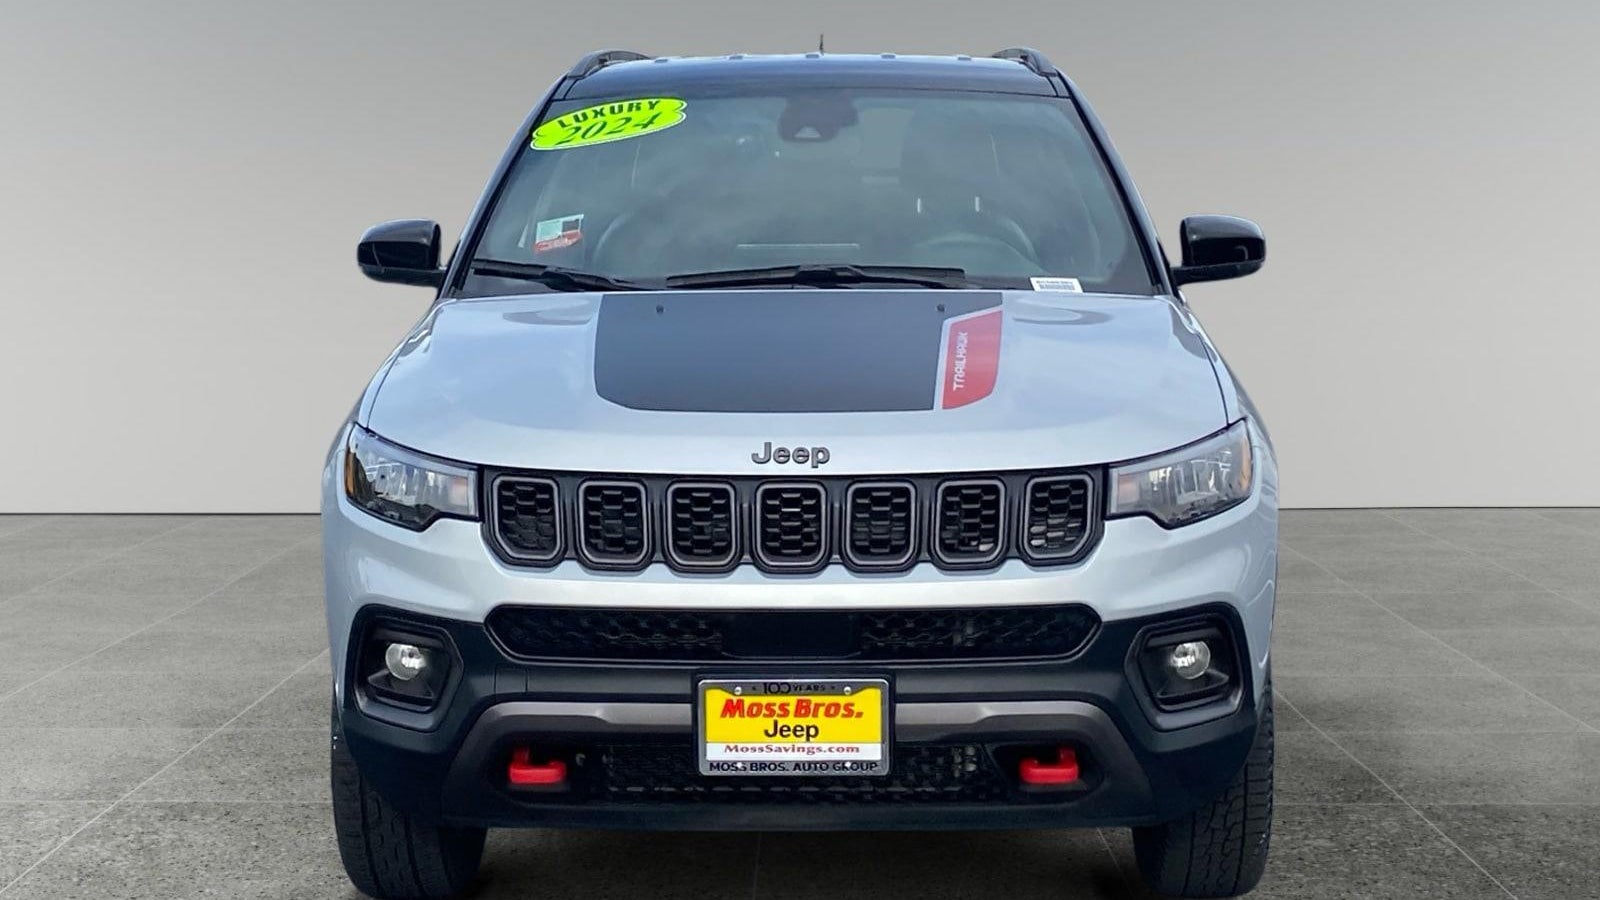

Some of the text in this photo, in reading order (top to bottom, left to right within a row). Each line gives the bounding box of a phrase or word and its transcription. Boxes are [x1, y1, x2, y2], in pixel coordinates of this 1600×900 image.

[557, 99, 661, 128] LUXURY
[554, 111, 662, 146] 2024
[952, 331, 968, 391] TRAILHAWK
[751, 441, 831, 469] Jeep
[720, 698, 864, 718] Moss Bros.
[764, 719, 819, 742] Jeep
[724, 744, 860, 755] MossSavings.com
[709, 762, 878, 772] MOSS BROS. AUTO GROUP
